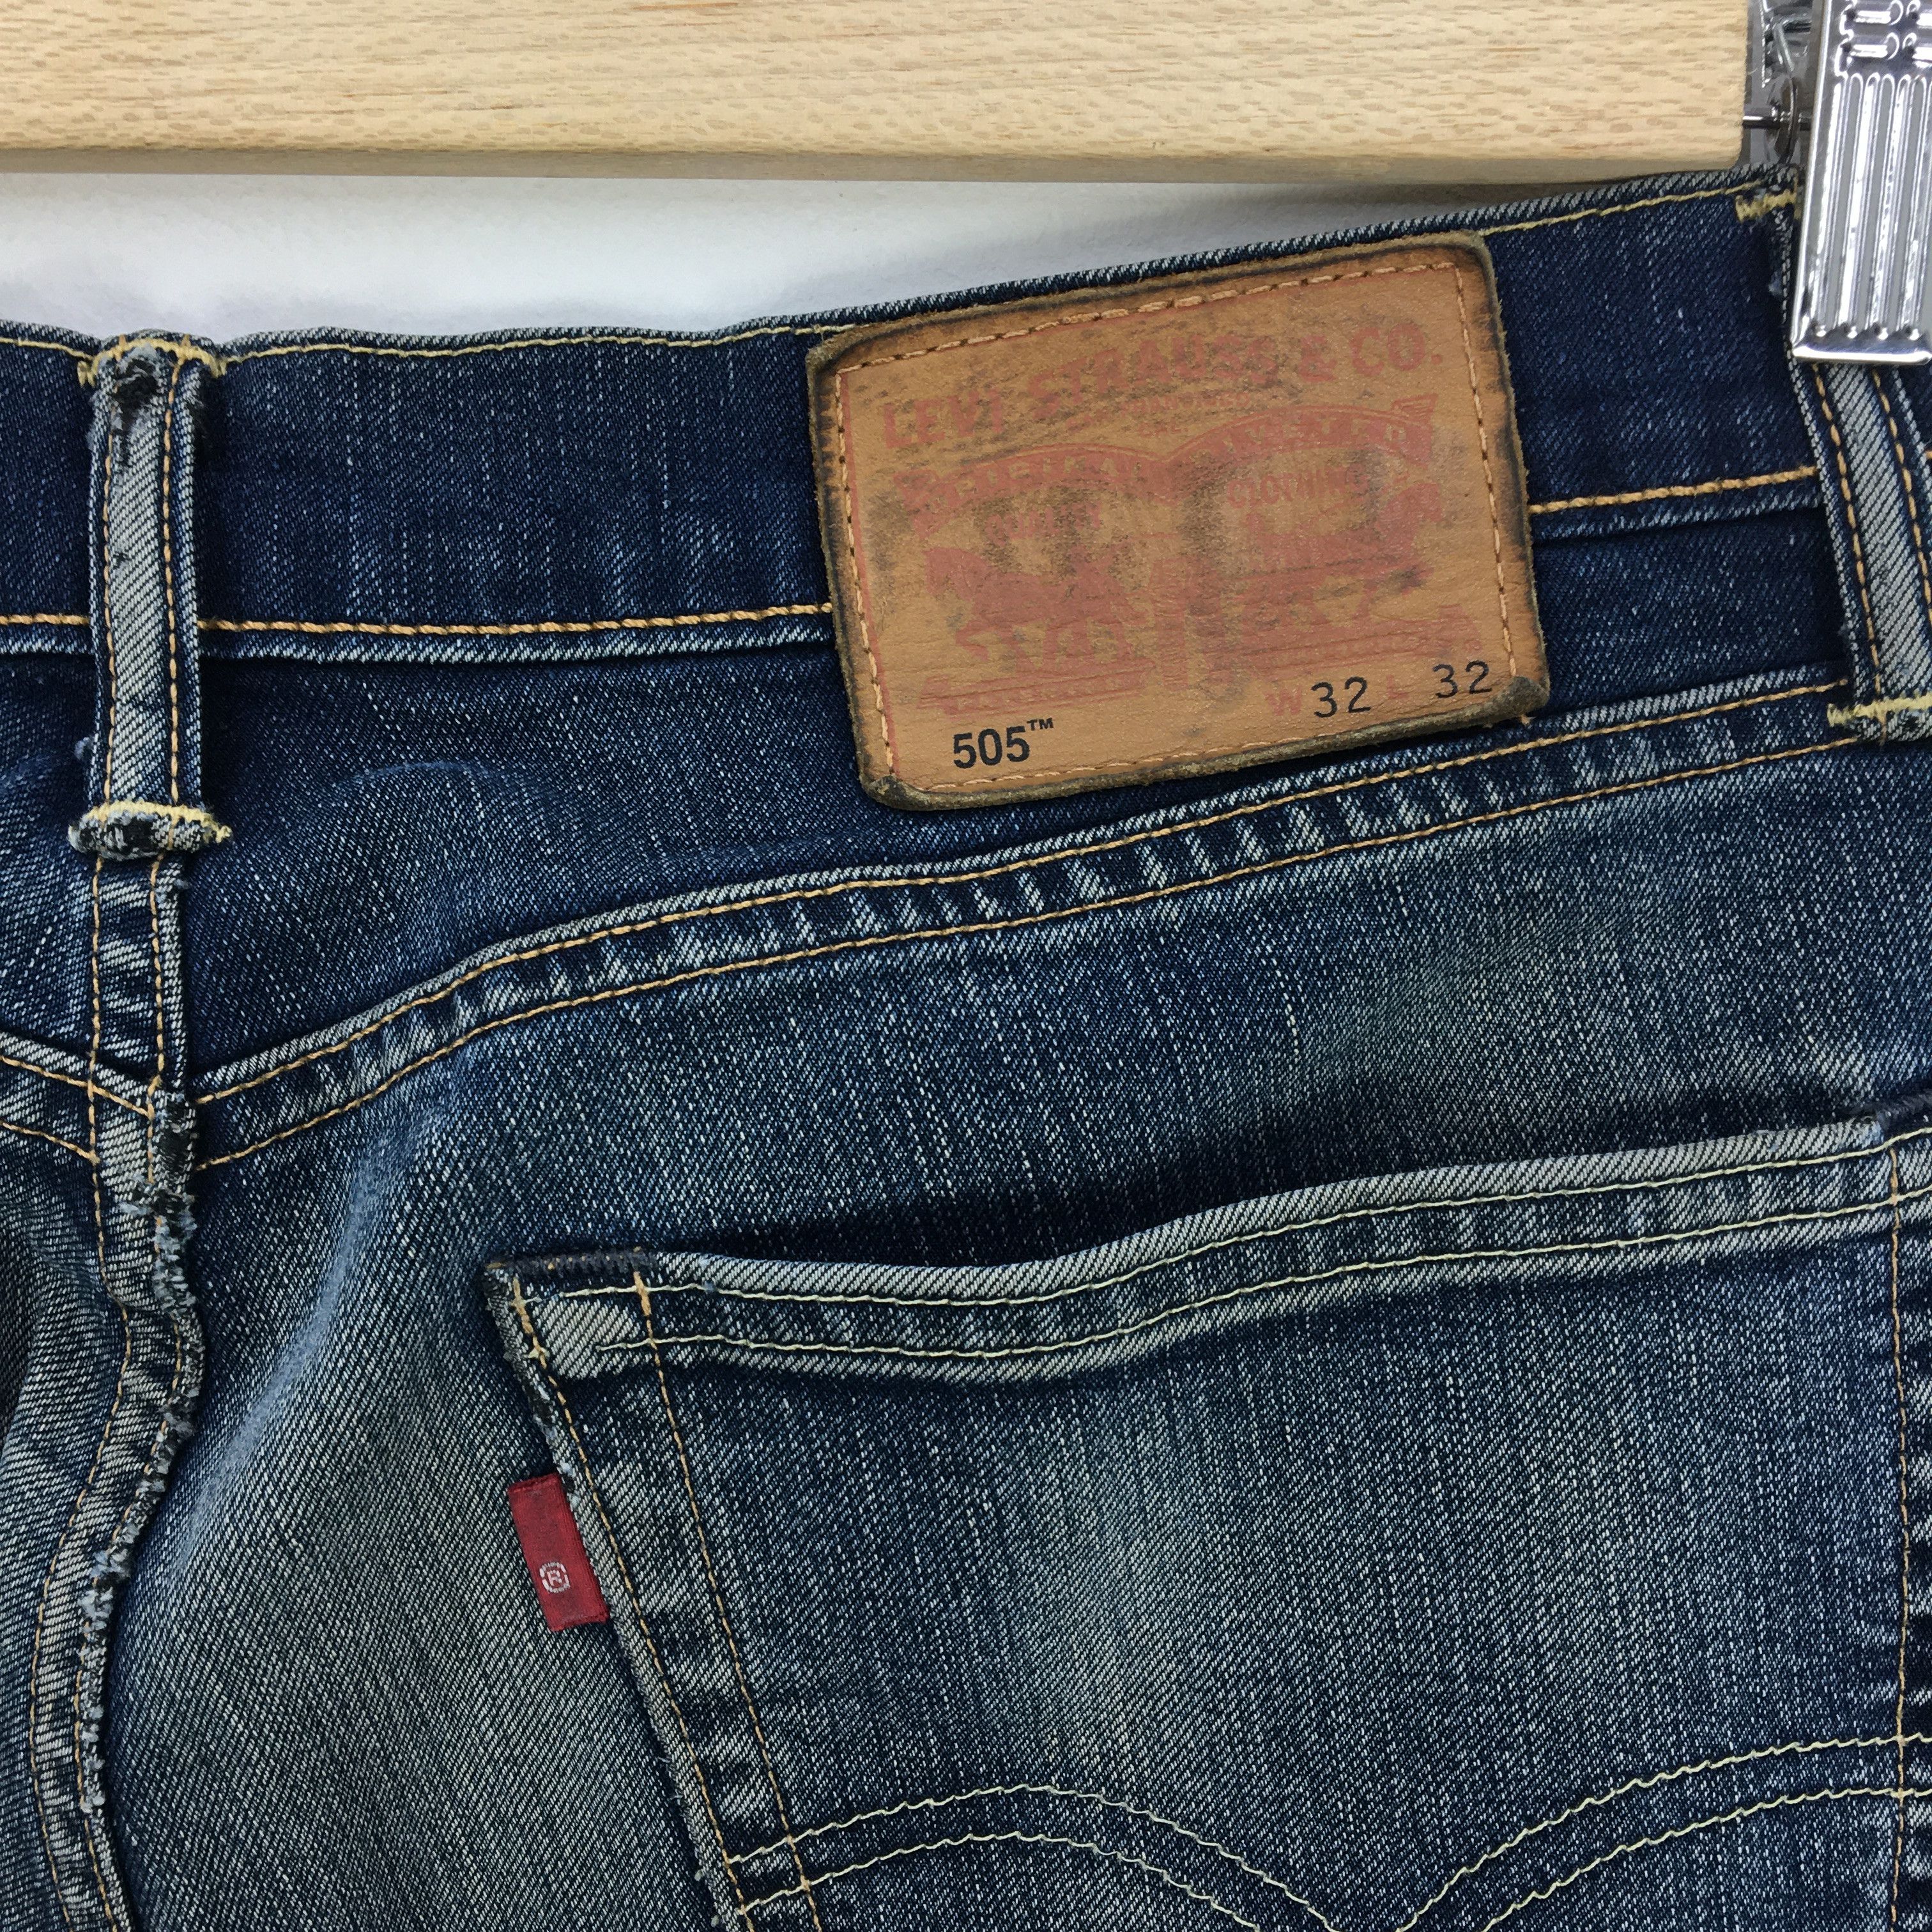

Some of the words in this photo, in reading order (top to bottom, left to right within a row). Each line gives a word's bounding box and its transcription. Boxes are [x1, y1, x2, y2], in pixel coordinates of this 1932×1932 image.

[882, 387, 1004, 449] LEVI
[1349, 323, 1443, 377] CO.
[1310, 676, 1372, 718] 32
[1432, 660, 1492, 699] 32
